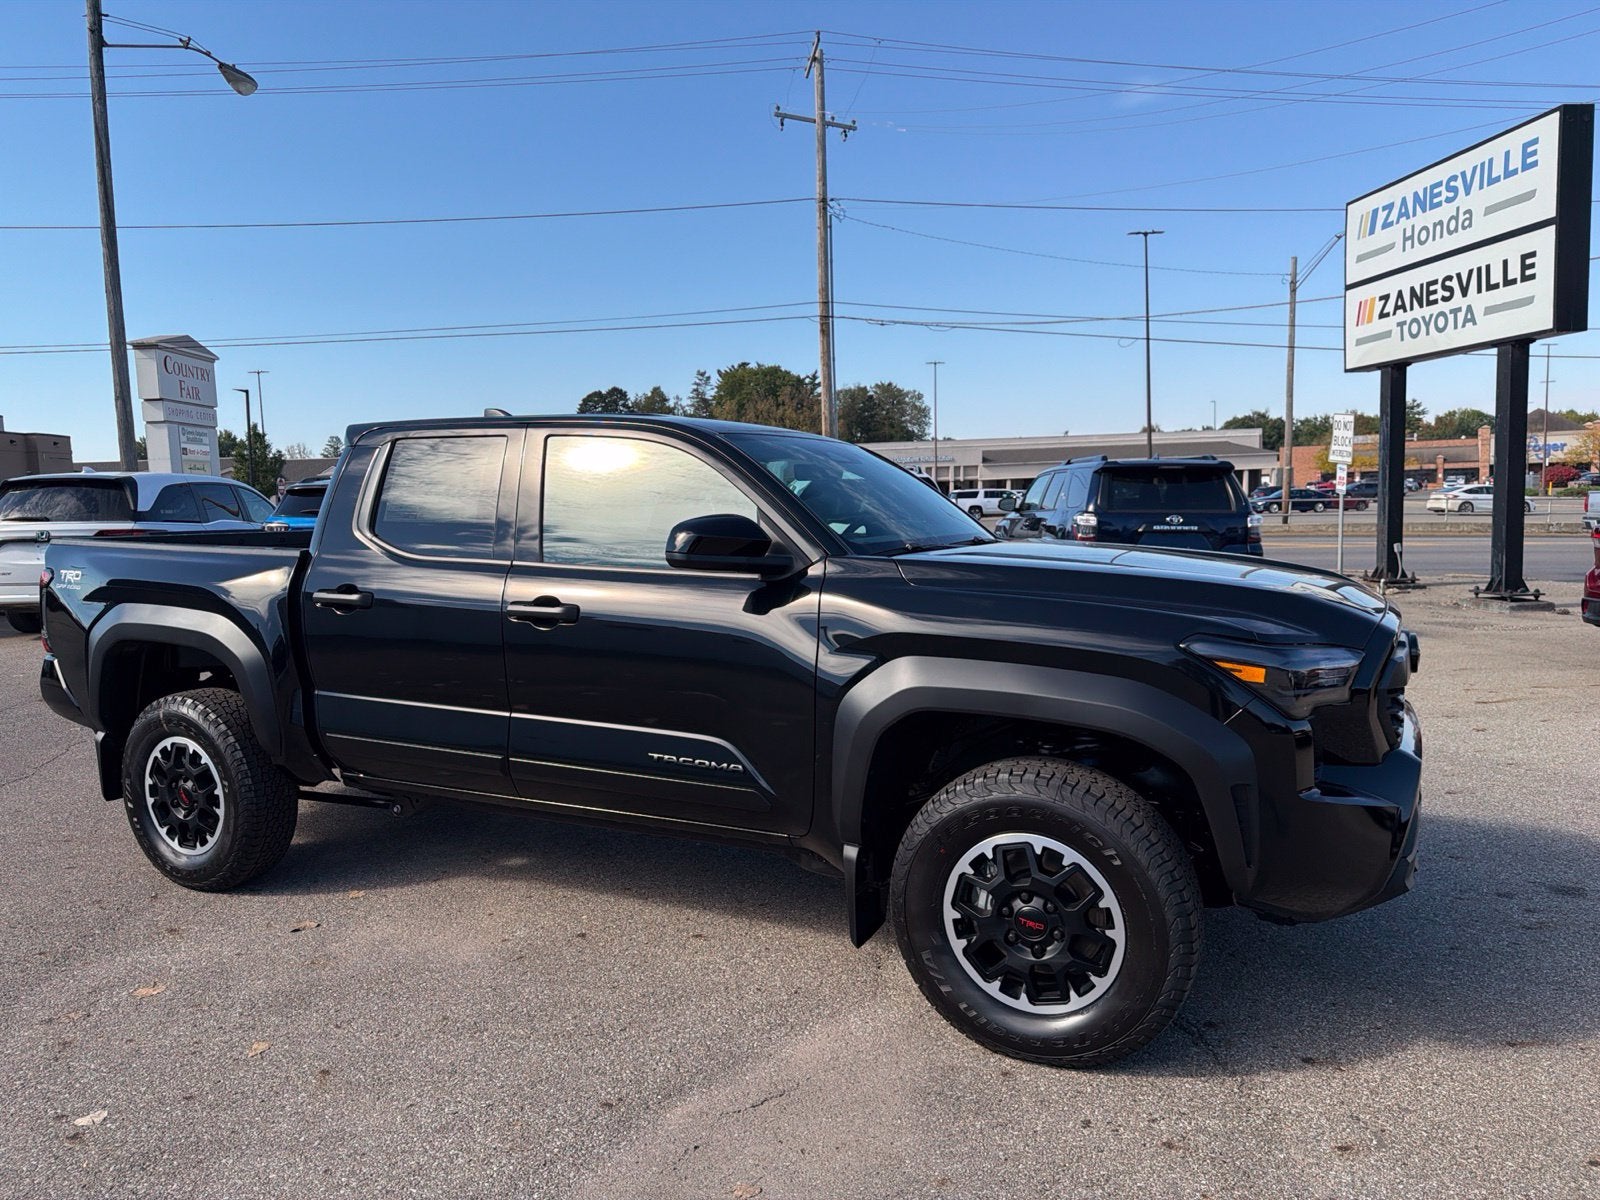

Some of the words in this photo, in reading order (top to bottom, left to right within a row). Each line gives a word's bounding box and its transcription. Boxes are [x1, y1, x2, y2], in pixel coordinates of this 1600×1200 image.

[1381, 136, 1540, 230] ZANESVILLE
[1401, 205, 1474, 252] Honda
[1377, 250, 1537, 320] ZANESVILLE
[1396, 304, 1477, 342] TOYOTA
[168, 408, 194, 419] SHOPPING
[1334, 420, 1341, 431] DO
[1343, 420, 1353, 432] NOT
[1333, 435, 1353, 447] BLOCK
[60, 569, 81, 583] TRD
[647, 752, 744, 773] TACOMA
[1018, 916, 1045, 930] TRD
